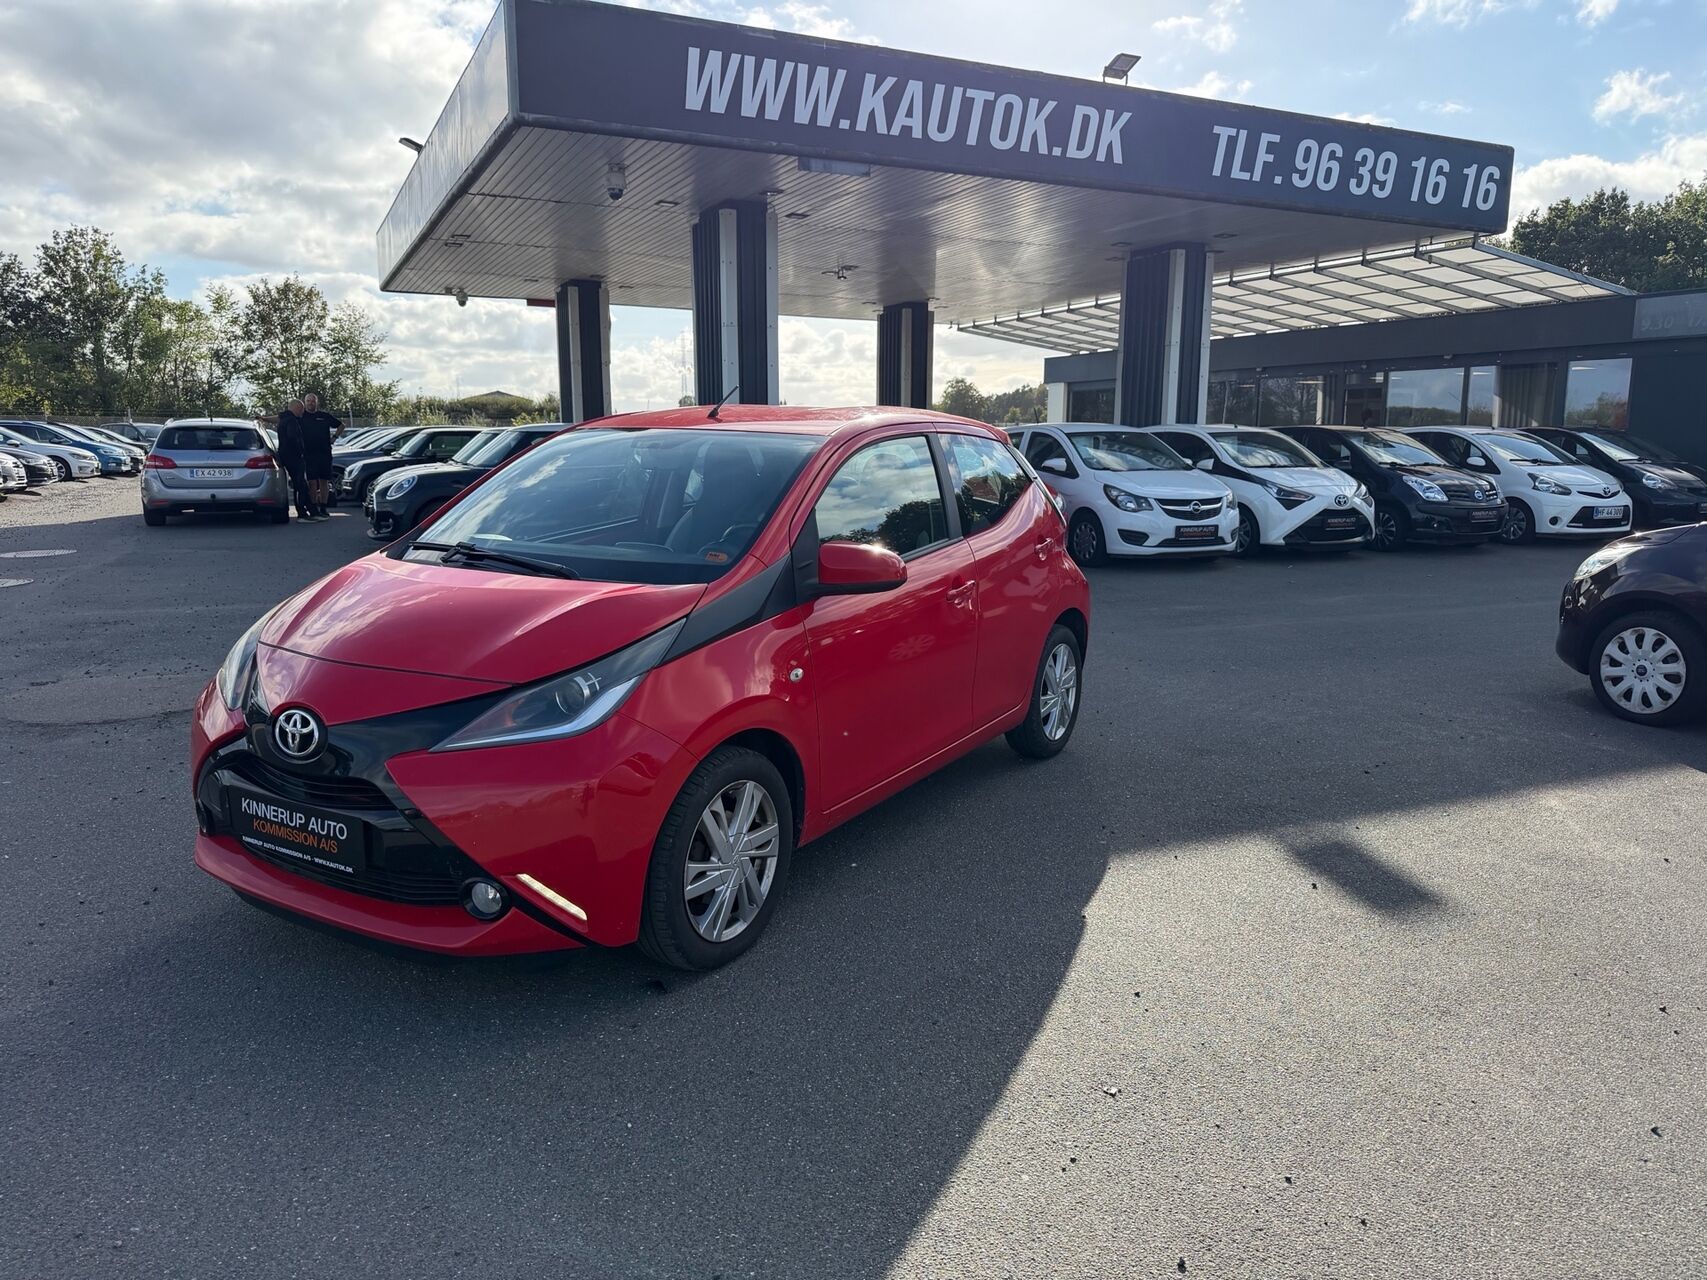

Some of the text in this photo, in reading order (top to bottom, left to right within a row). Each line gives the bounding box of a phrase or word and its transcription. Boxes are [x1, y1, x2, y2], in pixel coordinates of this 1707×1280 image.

[684, 46, 1133, 165] WWW.KAUTOK.DK
[1211, 125, 1501, 211] TLF. 96 39 16 16
[195, 469, 232, 477] EX 42 938
[241, 797, 348, 840] KINNERUP AUTO
[252, 817, 338, 854] KOMMISSION A/S
